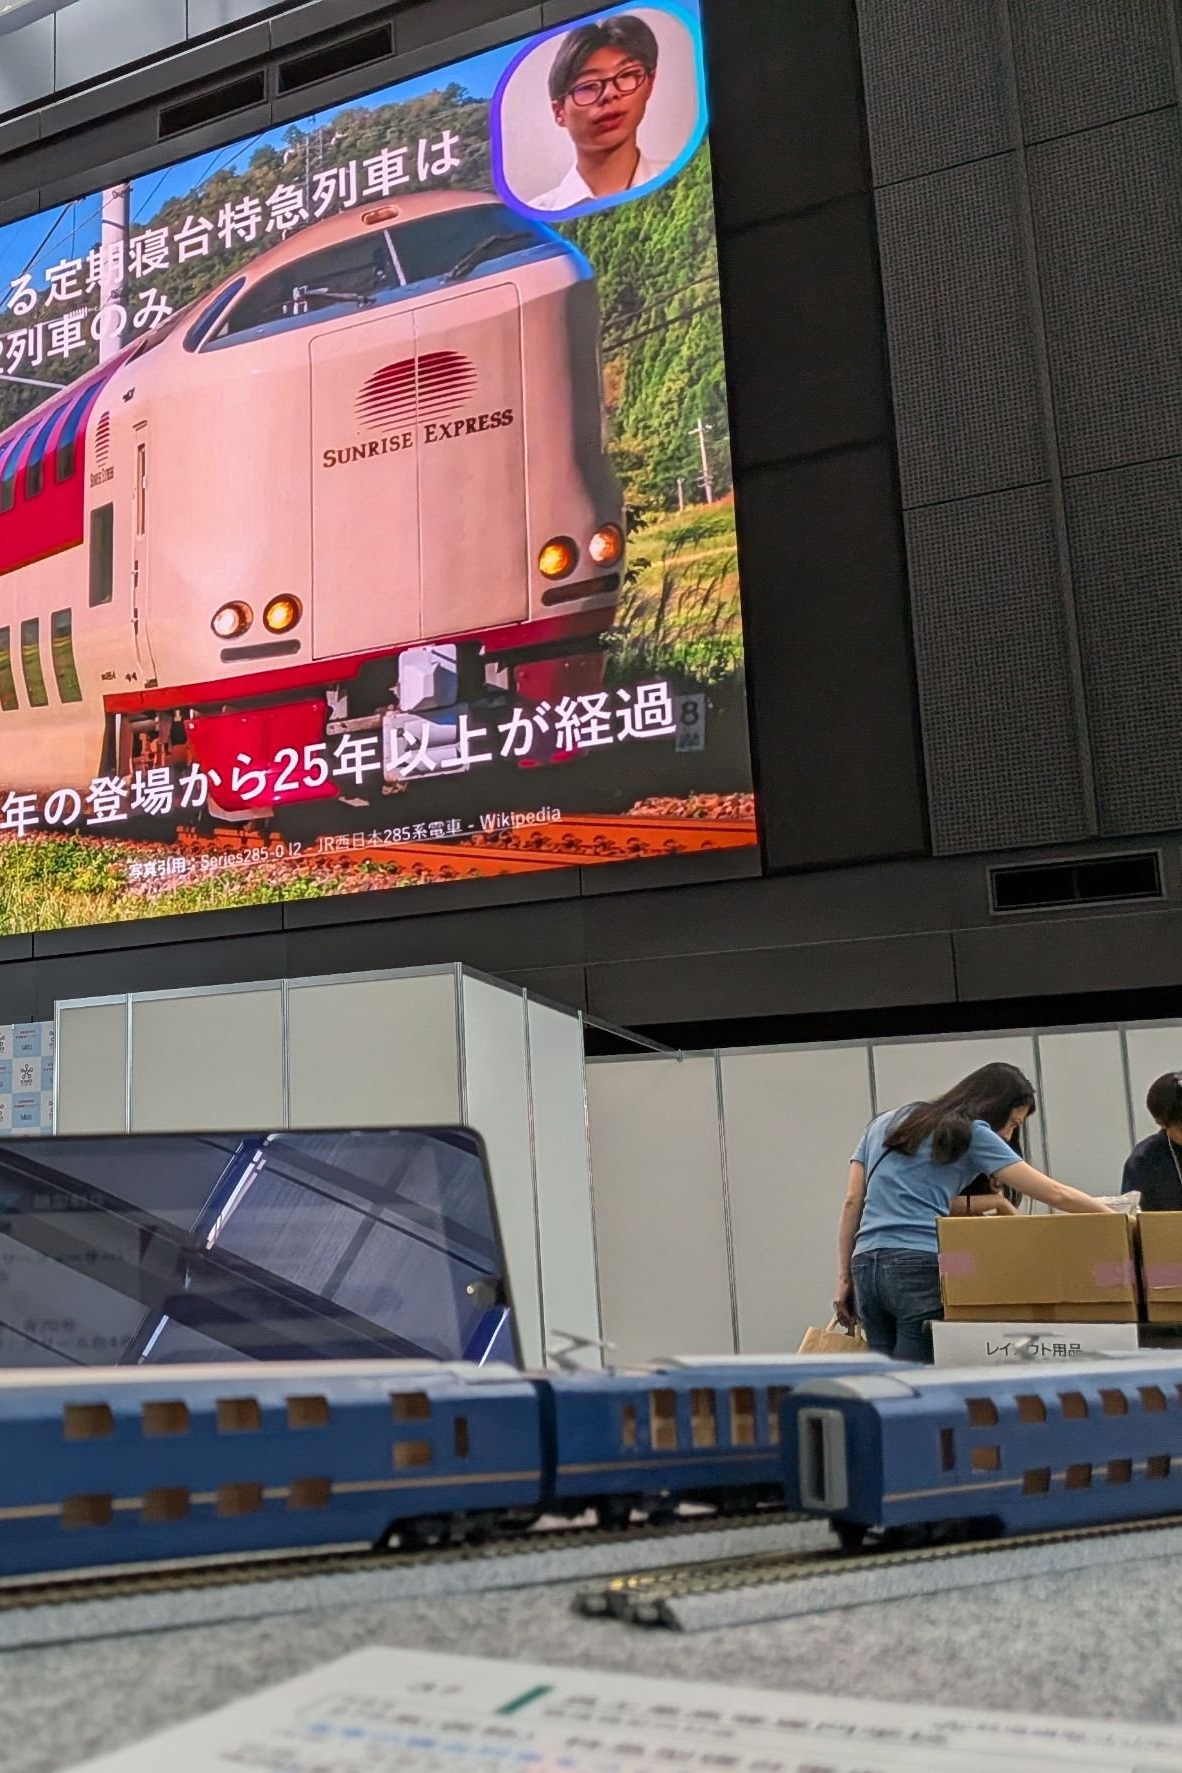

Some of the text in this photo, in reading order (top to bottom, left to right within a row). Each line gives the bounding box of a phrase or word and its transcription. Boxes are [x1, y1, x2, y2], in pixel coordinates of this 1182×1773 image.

[322, 408, 514, 468] SUNRISE EXPRESS
[680, 700, 699, 726] 8
[479, 807, 562, 830] Wikipedia
[986, 1341, 1082, 1358] レイウト用品
